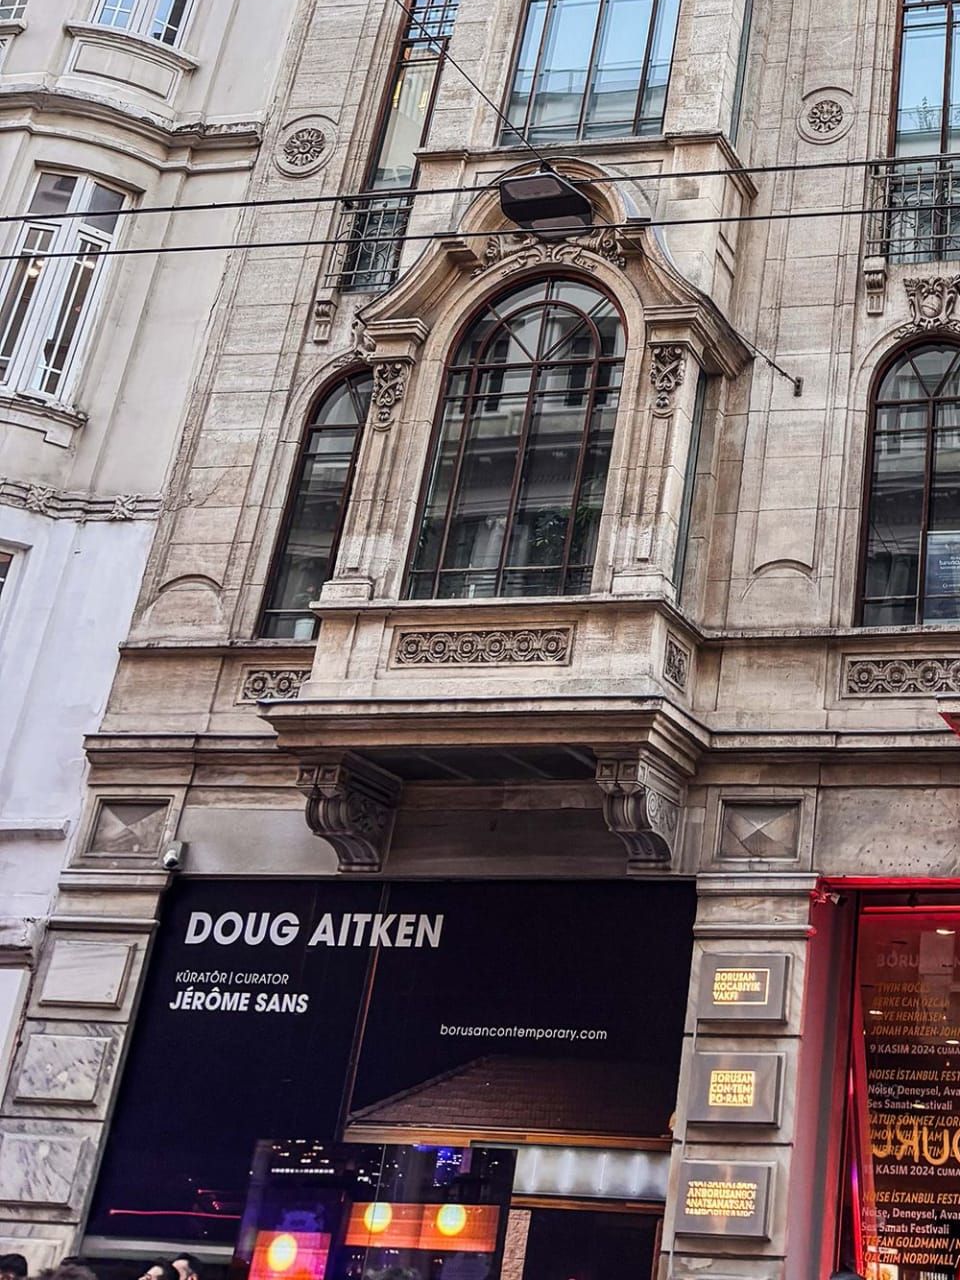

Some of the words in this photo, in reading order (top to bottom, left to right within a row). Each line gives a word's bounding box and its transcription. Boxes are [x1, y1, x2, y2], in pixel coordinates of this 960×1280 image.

[184, 911, 300, 946] DOUG
[308, 913, 444, 948] AITKEN
[235, 972, 289, 986] CURATOR
[169, 986, 250, 1012] JÉRÔME
[254, 993, 309, 1013] SANS
[440, 1024, 608, 1041] borusancontemporary.com
[869, 1044, 876, 1053] 9
[877, 1043, 910, 1054] KASIM
[911, 1044, 935, 1055] 2024
[868, 1069, 895, 1081] NOISE
[896, 1067, 940, 1082] İSTANBUL
[897, 1085, 941, 1098] Deneysel,
[876, 1163, 909, 1175] KASIM
[910, 1165, 935, 1176] 2024
[891, 1189, 936, 1204] İSTANBUL
[892, 1208, 937, 1221] Deneysel,
[910, 1223, 950, 1235] Festivali
[896, 1236, 949, 1250] GOLDMANN
[902, 1253, 954, 1266] NORDWALL
